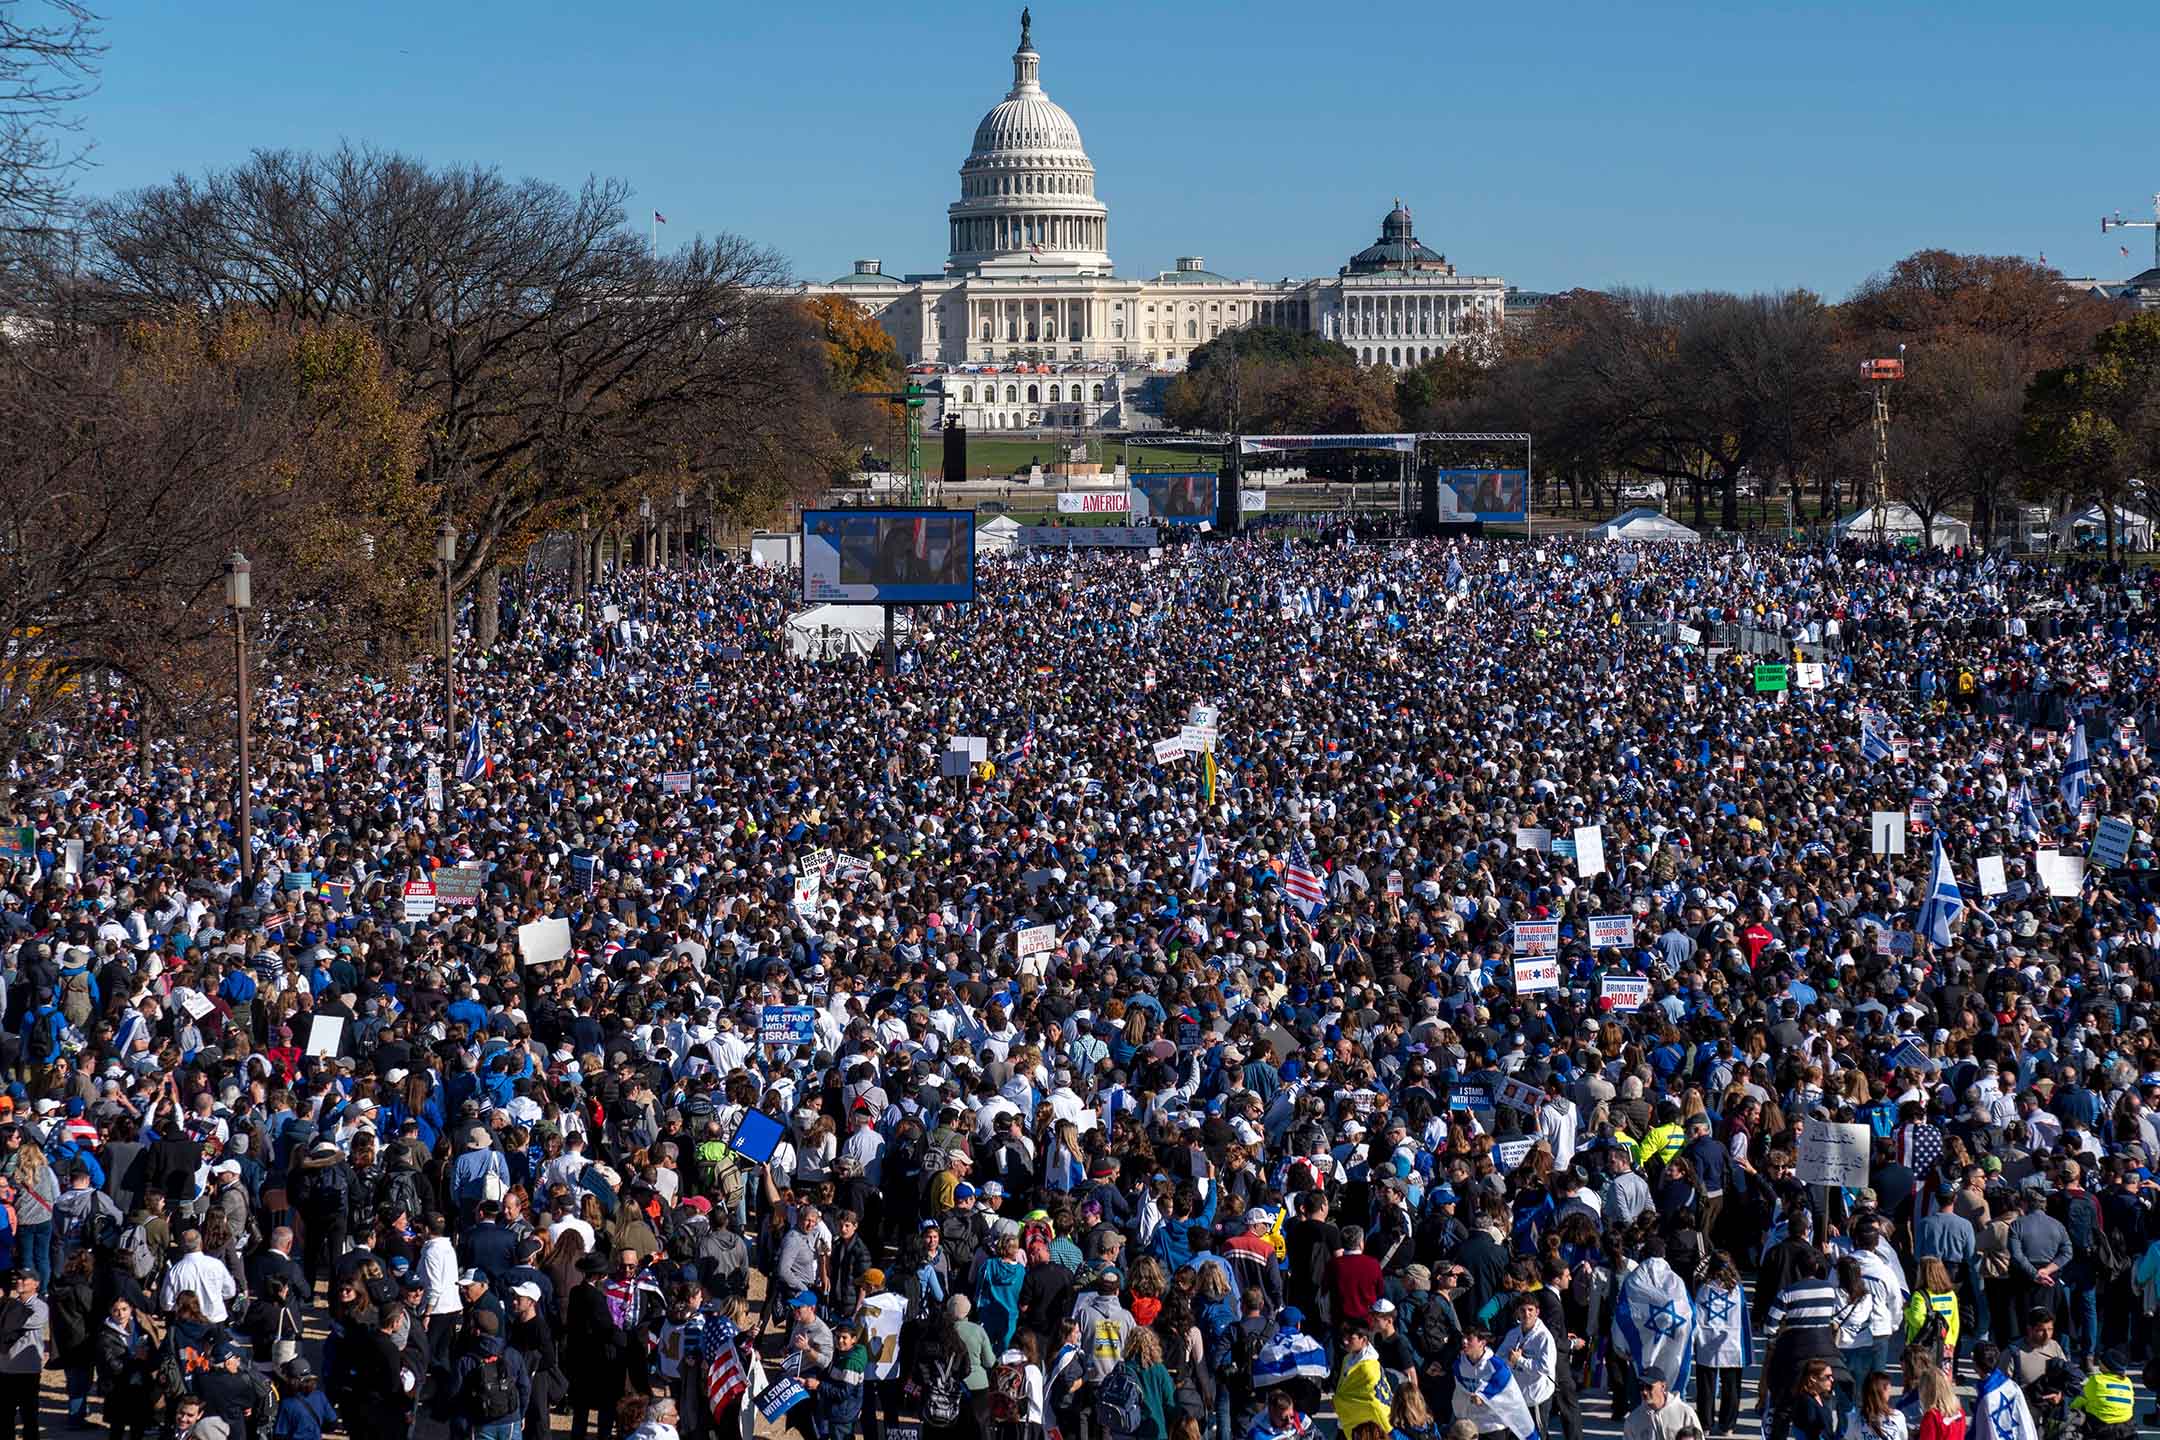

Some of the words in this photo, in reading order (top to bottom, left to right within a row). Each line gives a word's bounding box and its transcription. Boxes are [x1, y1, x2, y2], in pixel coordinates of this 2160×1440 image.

[1082, 494, 1131, 512] AMERICA
[1159, 748, 1184, 761] HAMAS
[1595, 921, 1614, 929] MAKE
[1614, 920, 1627, 928] OUR
[1519, 926, 1554, 934] MILWAUKEE
[1594, 928, 1628, 937] CAMPUSES
[1516, 933, 1540, 942] STANDS
[1540, 933, 1557, 941] WITH
[1601, 936, 1616, 944] SAFE
[1023, 941, 1052, 954] HOME
[1516, 968, 1533, 981] MKE
[1606, 983, 1626, 993] BRING
[1626, 984, 1645, 993] THEM
[1610, 993, 1638, 1006] HOME
[765, 1014, 780, 1022] WE
[781, 1014, 811, 1022] STAND
[765, 1022, 786, 1030] WITH
[765, 1031, 801, 1041] ISRAEL
[1464, 1087, 1484, 1095] STAND
[1451, 1095, 1468, 1104] WITH
[1469, 1096, 1489, 1105] ISRAEL
[1502, 1143, 1516, 1151] NEW
[763, 1394, 771, 1404] I
[767, 1377, 792, 1400] STAND
[762, 1397, 783, 1417] WITH
[779, 1383, 805, 1402] ISRAEL
[886, 1428, 918, 1438] NEVER
